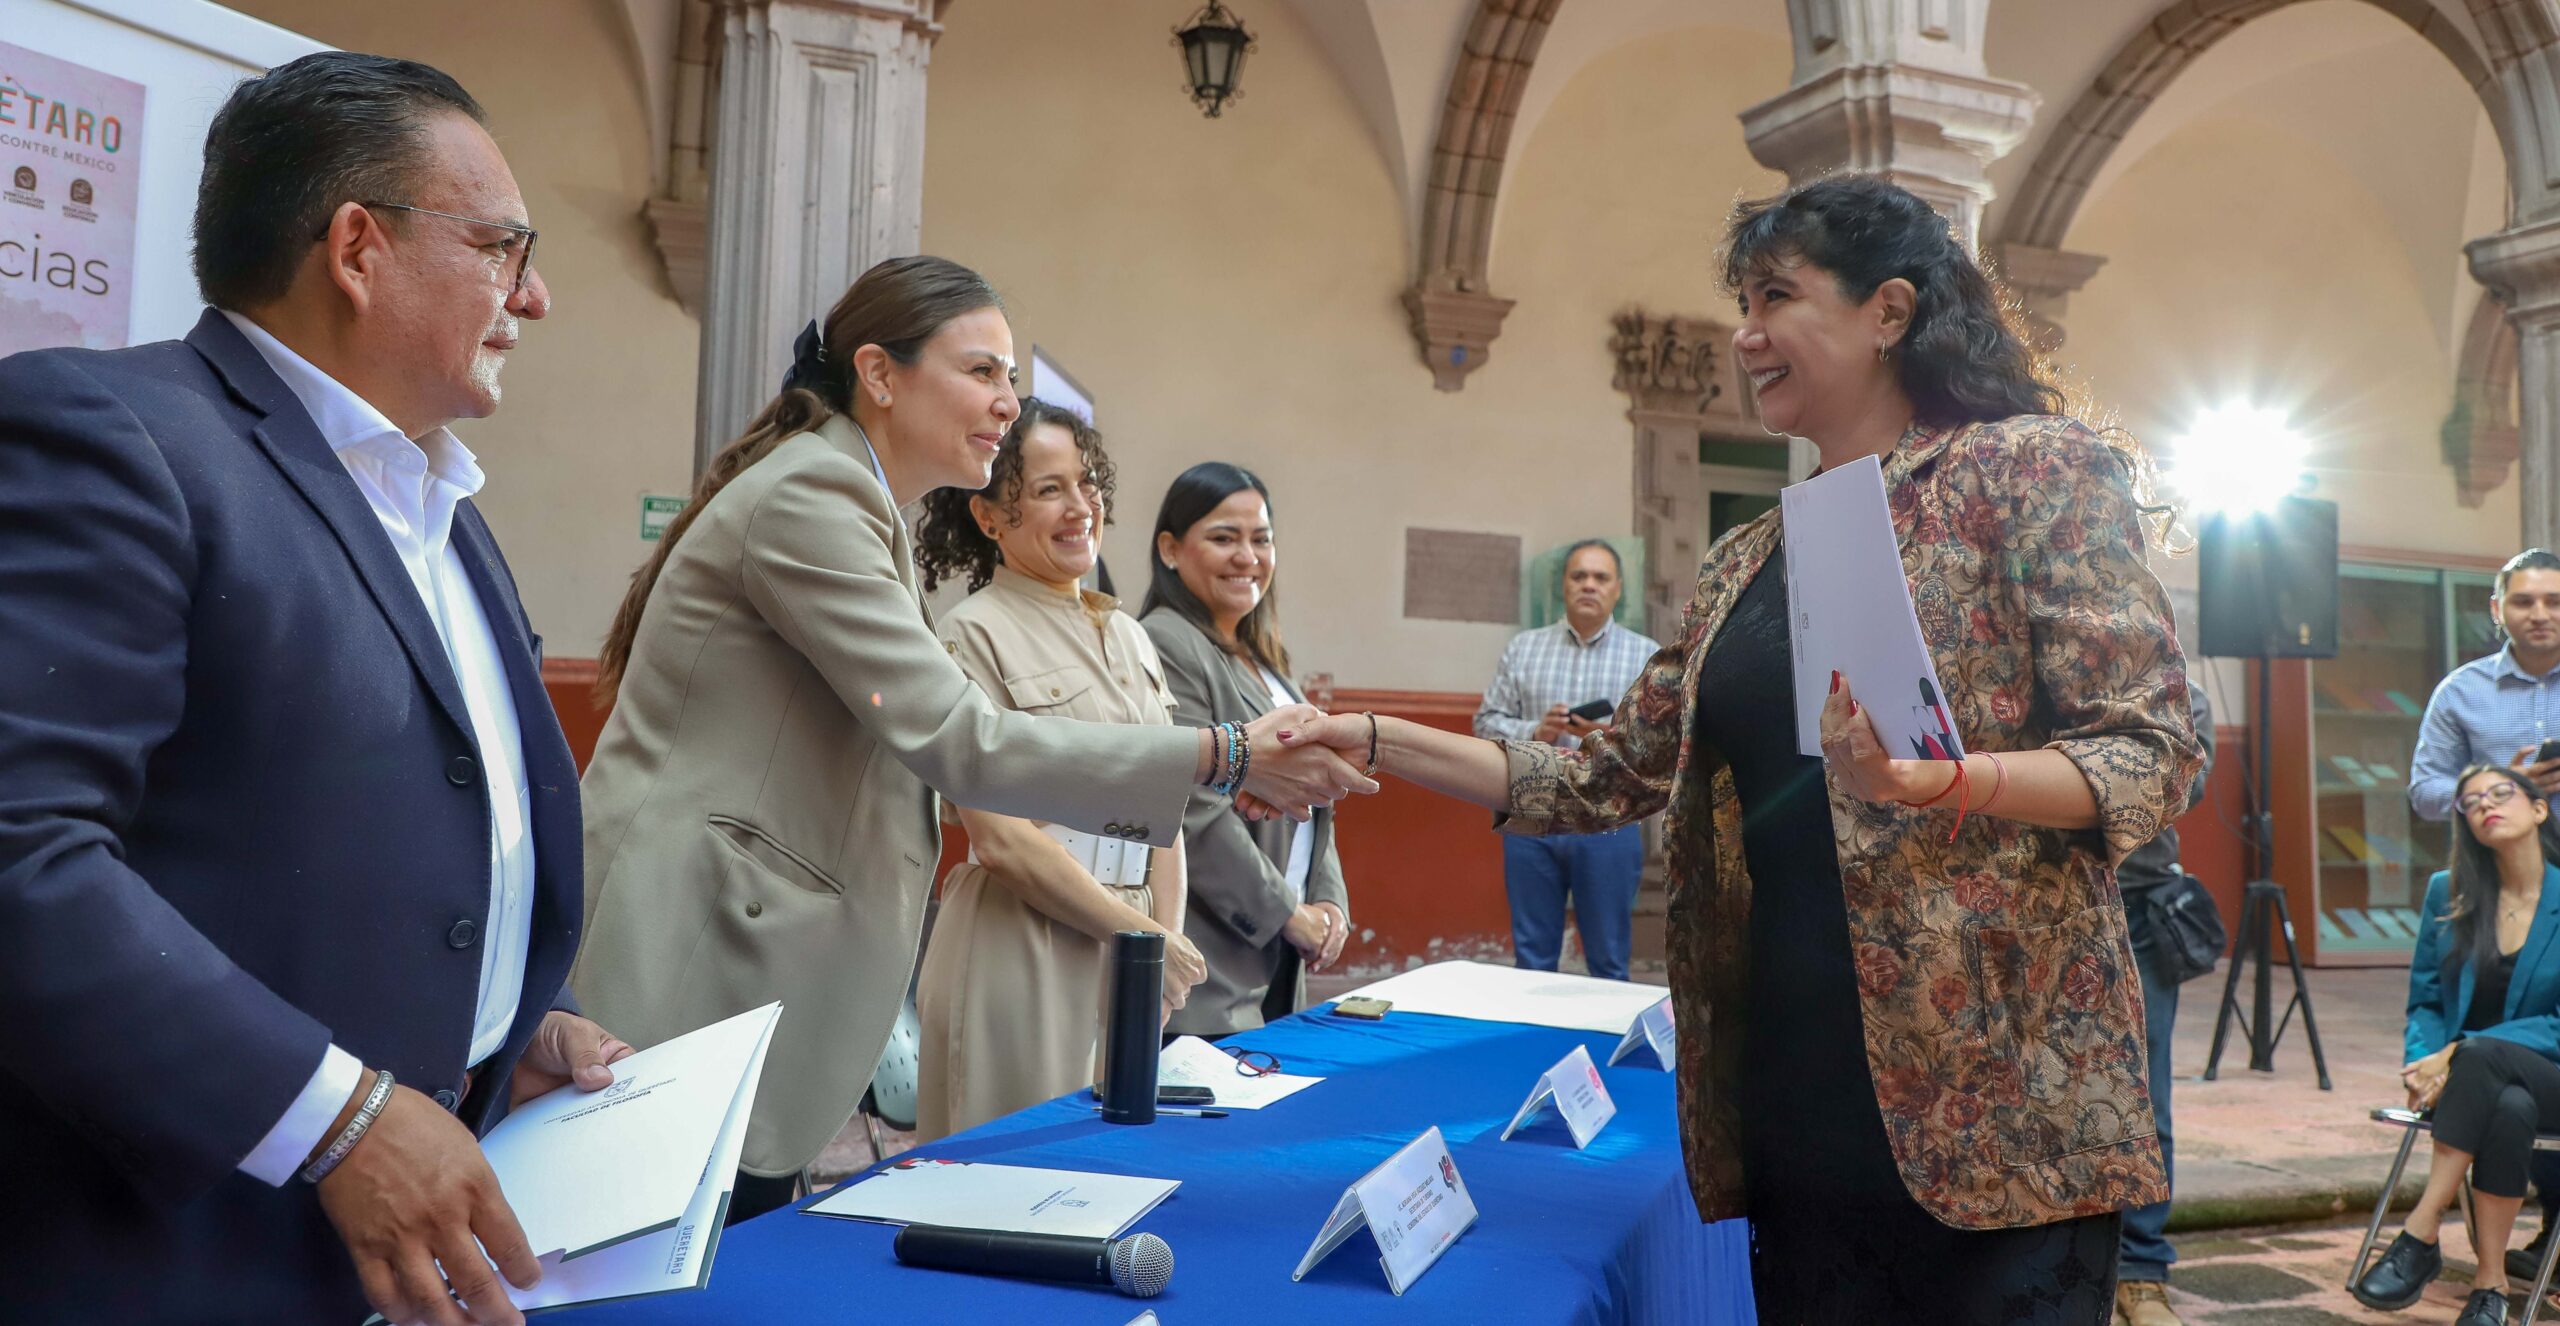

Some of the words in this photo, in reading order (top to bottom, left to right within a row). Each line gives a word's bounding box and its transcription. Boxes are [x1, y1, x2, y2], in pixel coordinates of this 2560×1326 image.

[0, 233, 109, 296] cias
[561, 1107, 599, 1123] FACULTAD
[671, 1224, 695, 1275] QUERÉTARO
